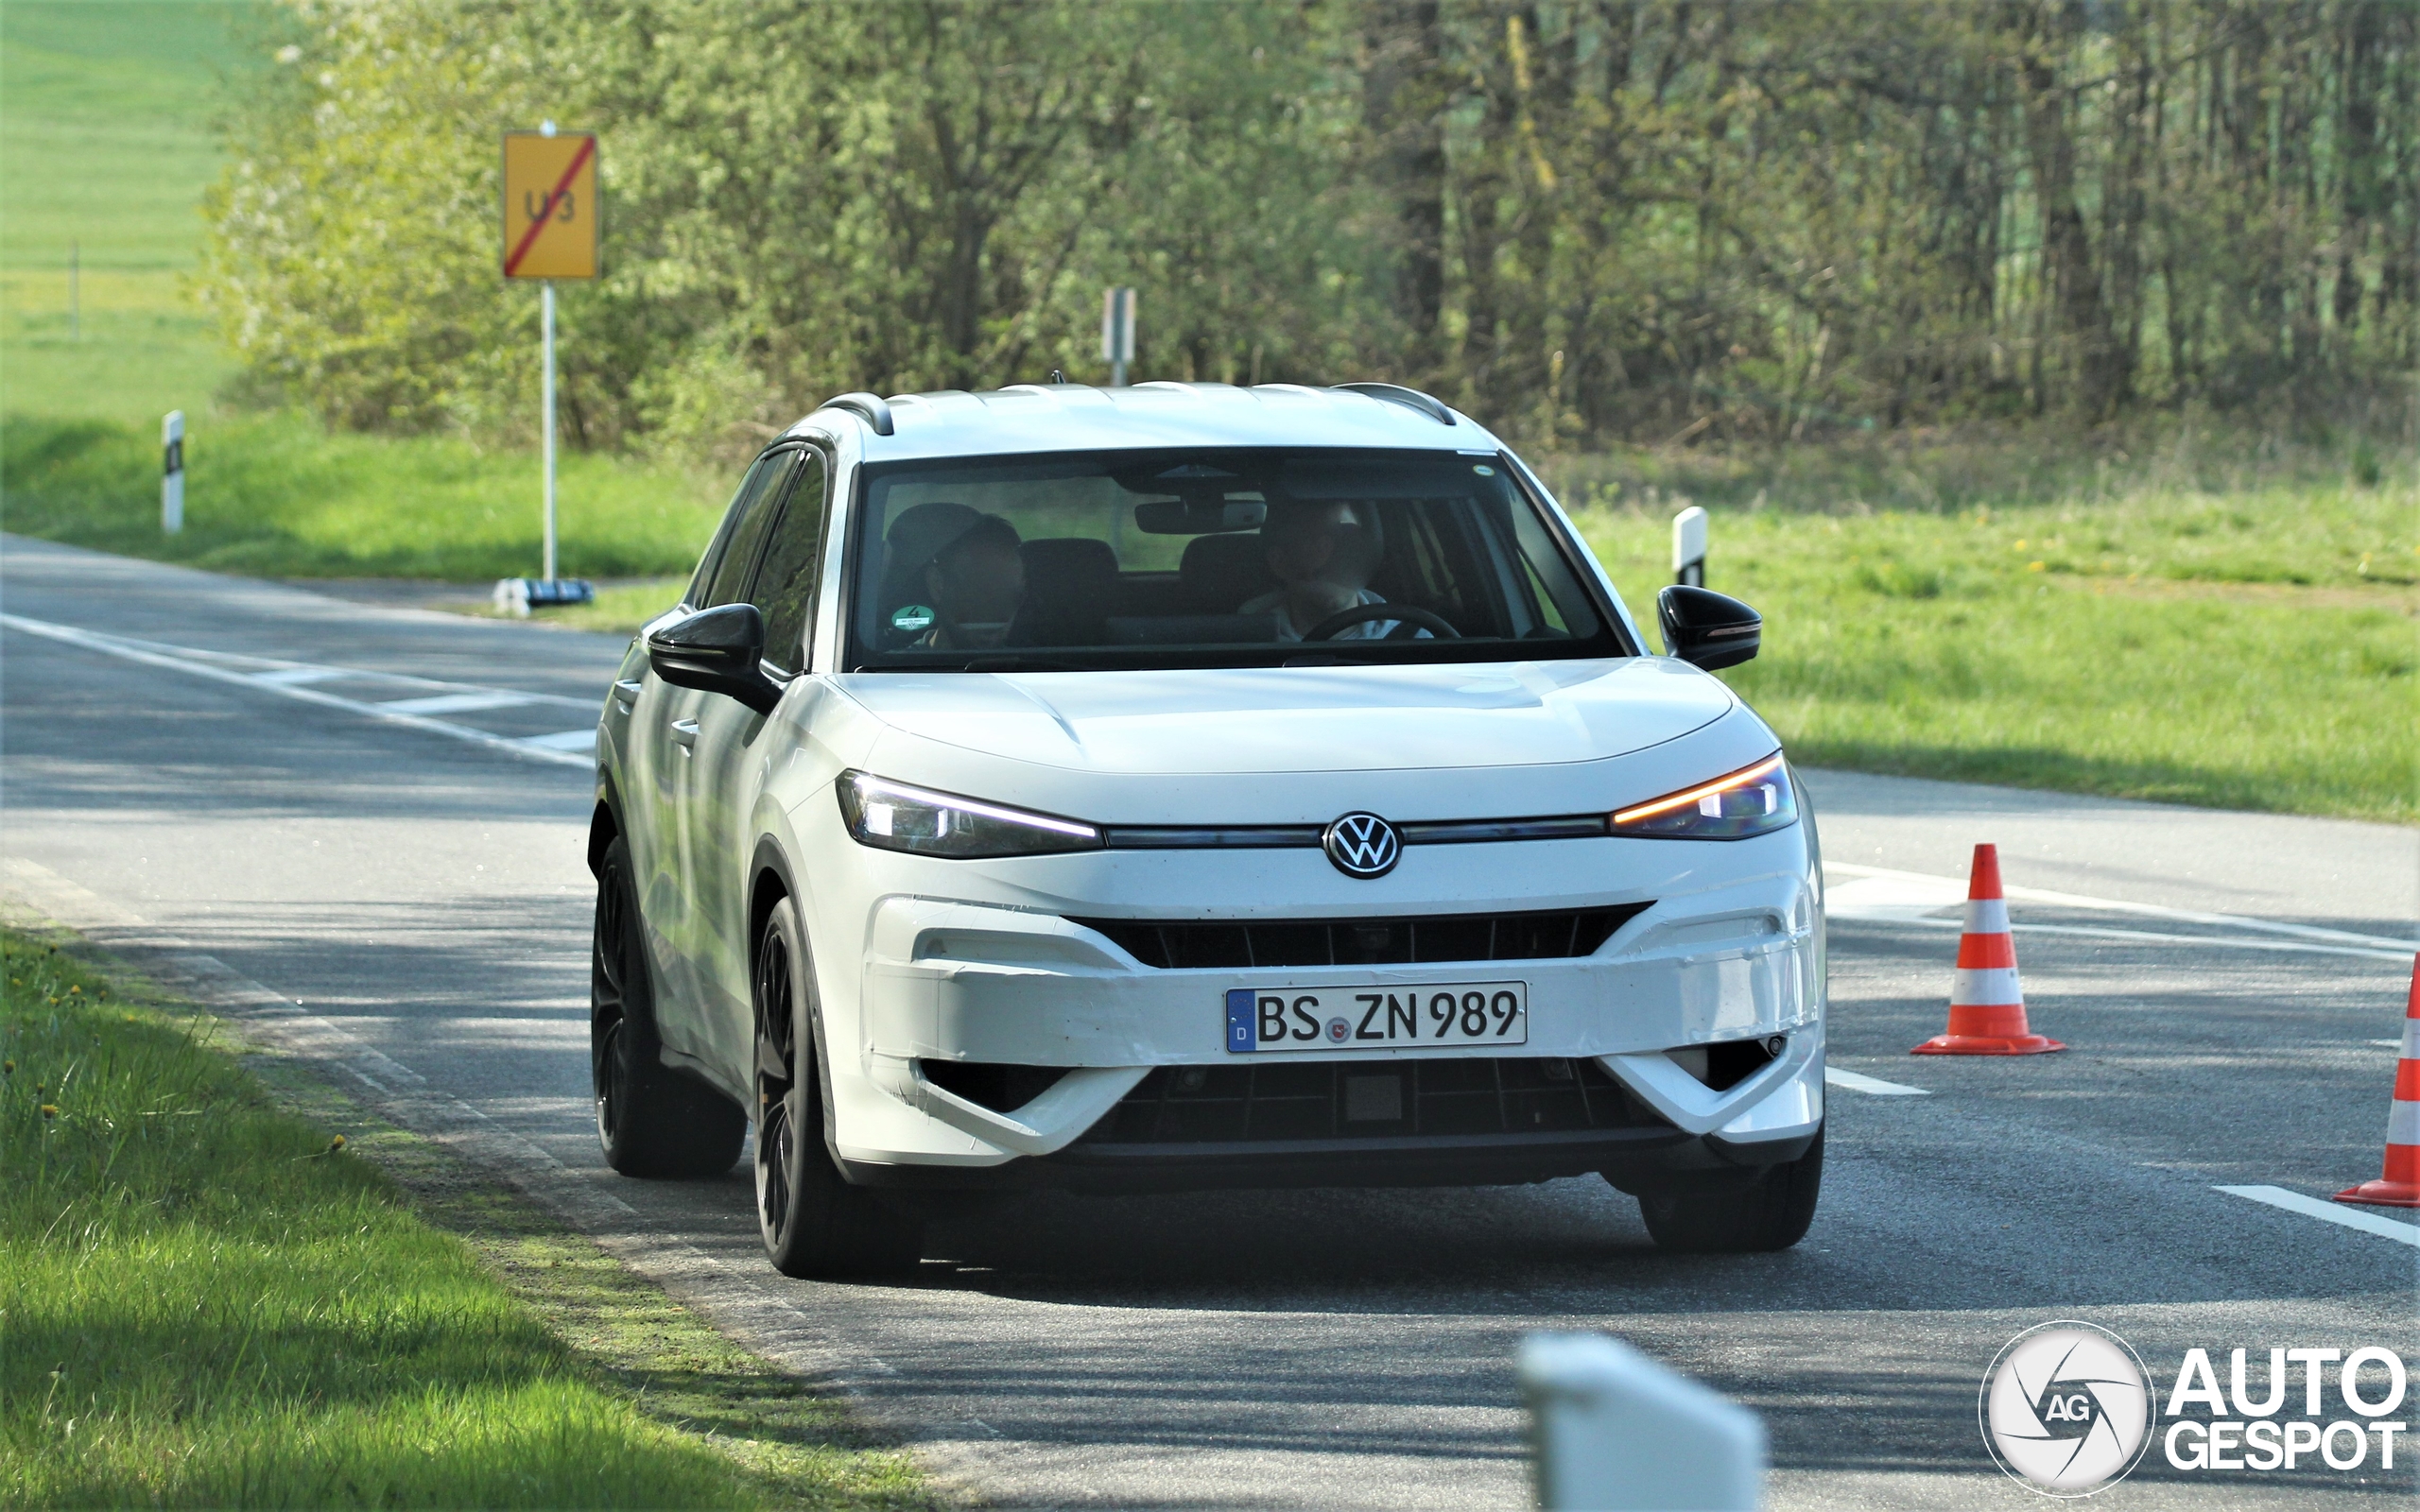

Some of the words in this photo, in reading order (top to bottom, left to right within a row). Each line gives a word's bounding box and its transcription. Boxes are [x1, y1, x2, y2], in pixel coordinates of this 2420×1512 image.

[1334, 817, 1392, 866] VW
[1236, 1027, 1247, 1040] D
[1258, 996, 1321, 1042] BS
[1355, 993, 1417, 1040] ZN
[1429, 990, 1518, 1038] 989
